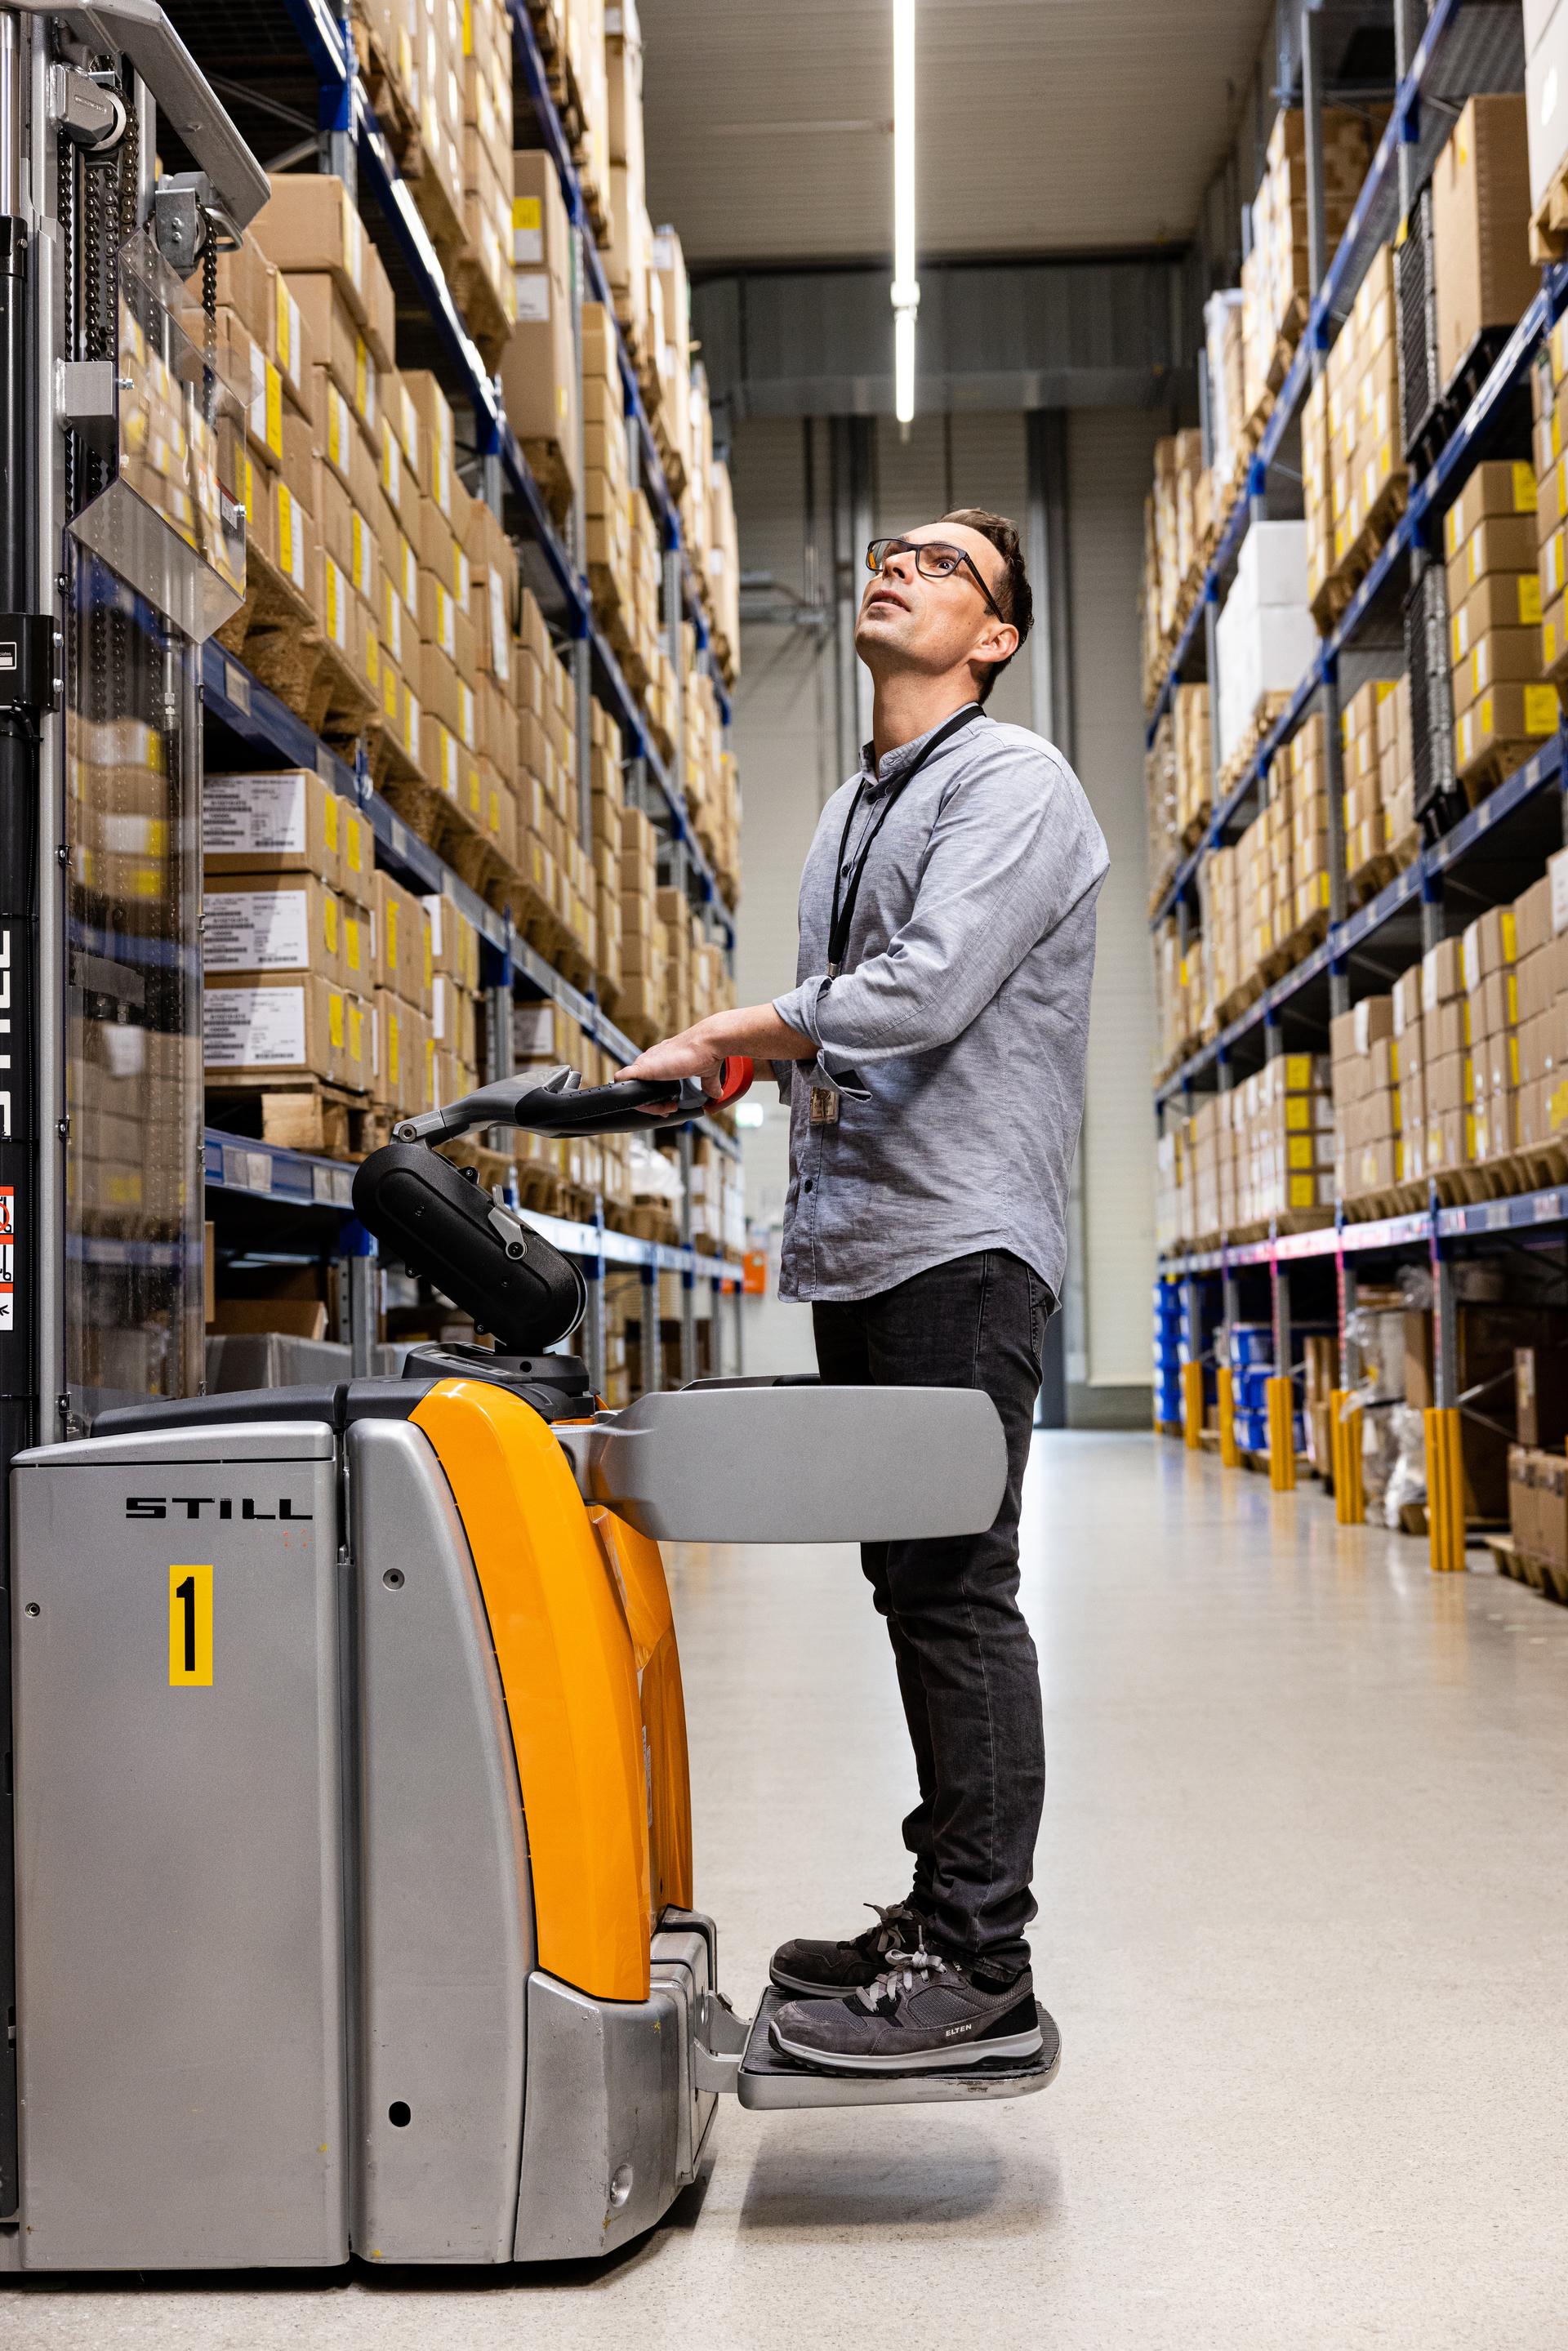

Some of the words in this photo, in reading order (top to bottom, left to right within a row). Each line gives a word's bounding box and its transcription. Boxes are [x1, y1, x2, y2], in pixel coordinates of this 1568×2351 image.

[126, 1498, 313, 1521] STILL
[176, 1576, 195, 1672] 1
[946, 2024, 972, 2037] ELTEN
